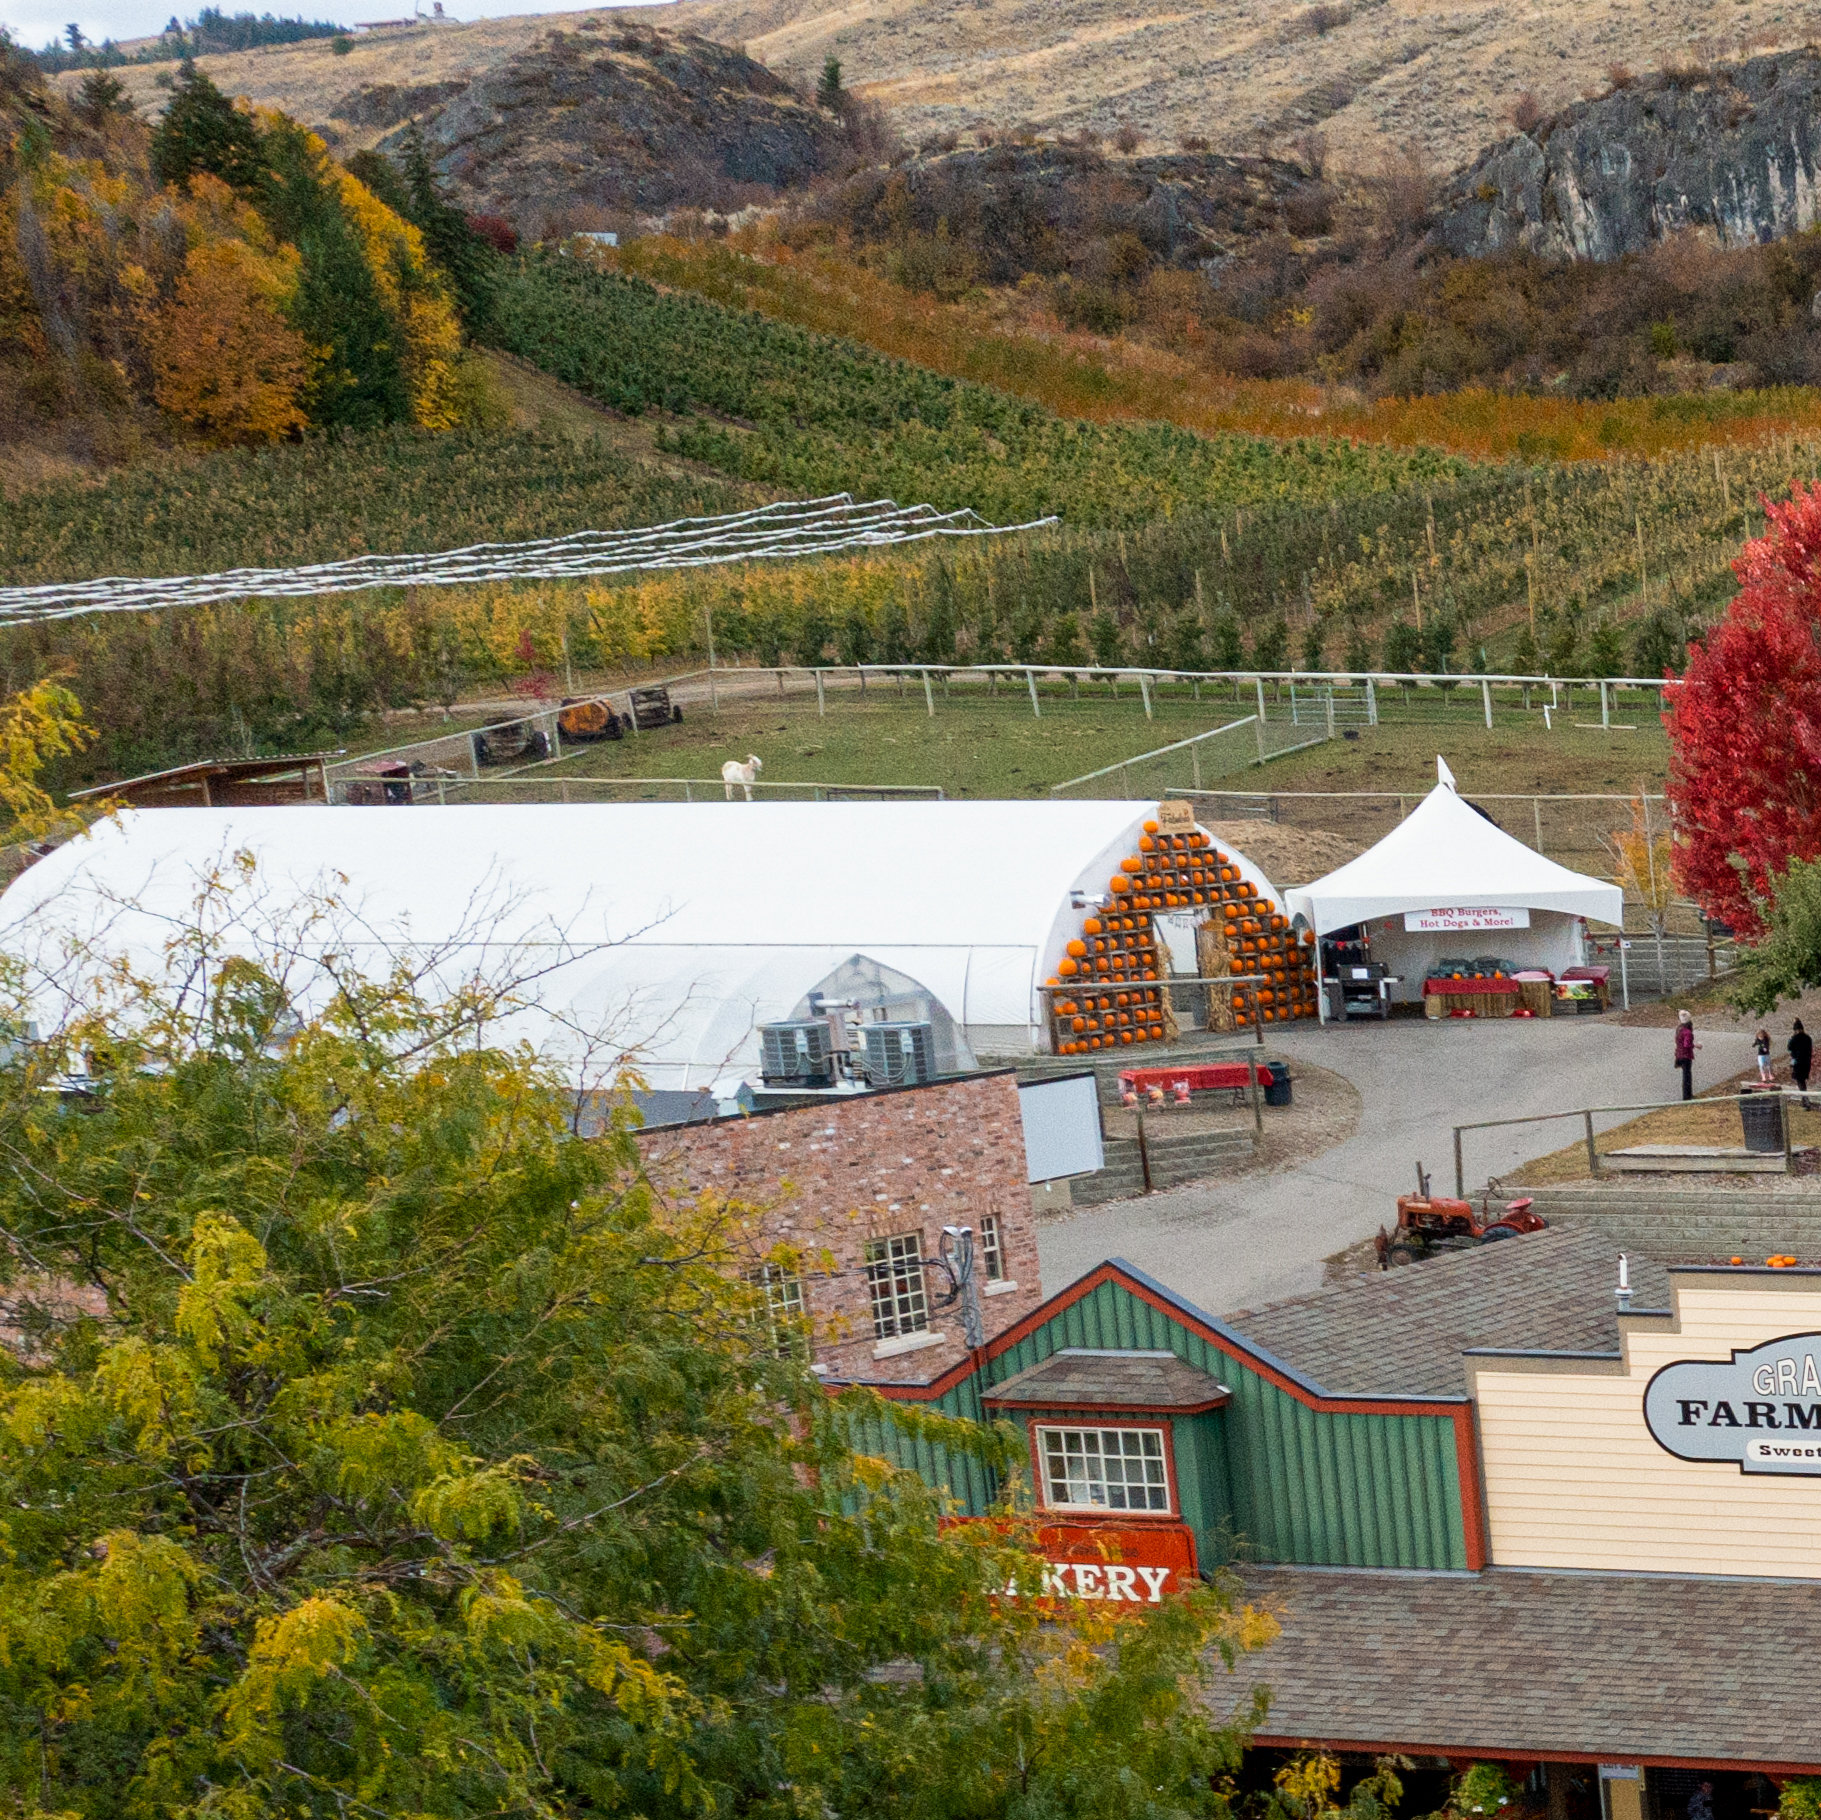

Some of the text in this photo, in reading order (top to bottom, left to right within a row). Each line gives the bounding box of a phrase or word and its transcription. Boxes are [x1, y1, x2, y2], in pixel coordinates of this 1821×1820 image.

[1430, 907, 1501, 918] BBQ Burgers,
[1420, 917, 1514, 928] Hot Dogs & More!
[983, 1562, 1171, 1603] KERY
